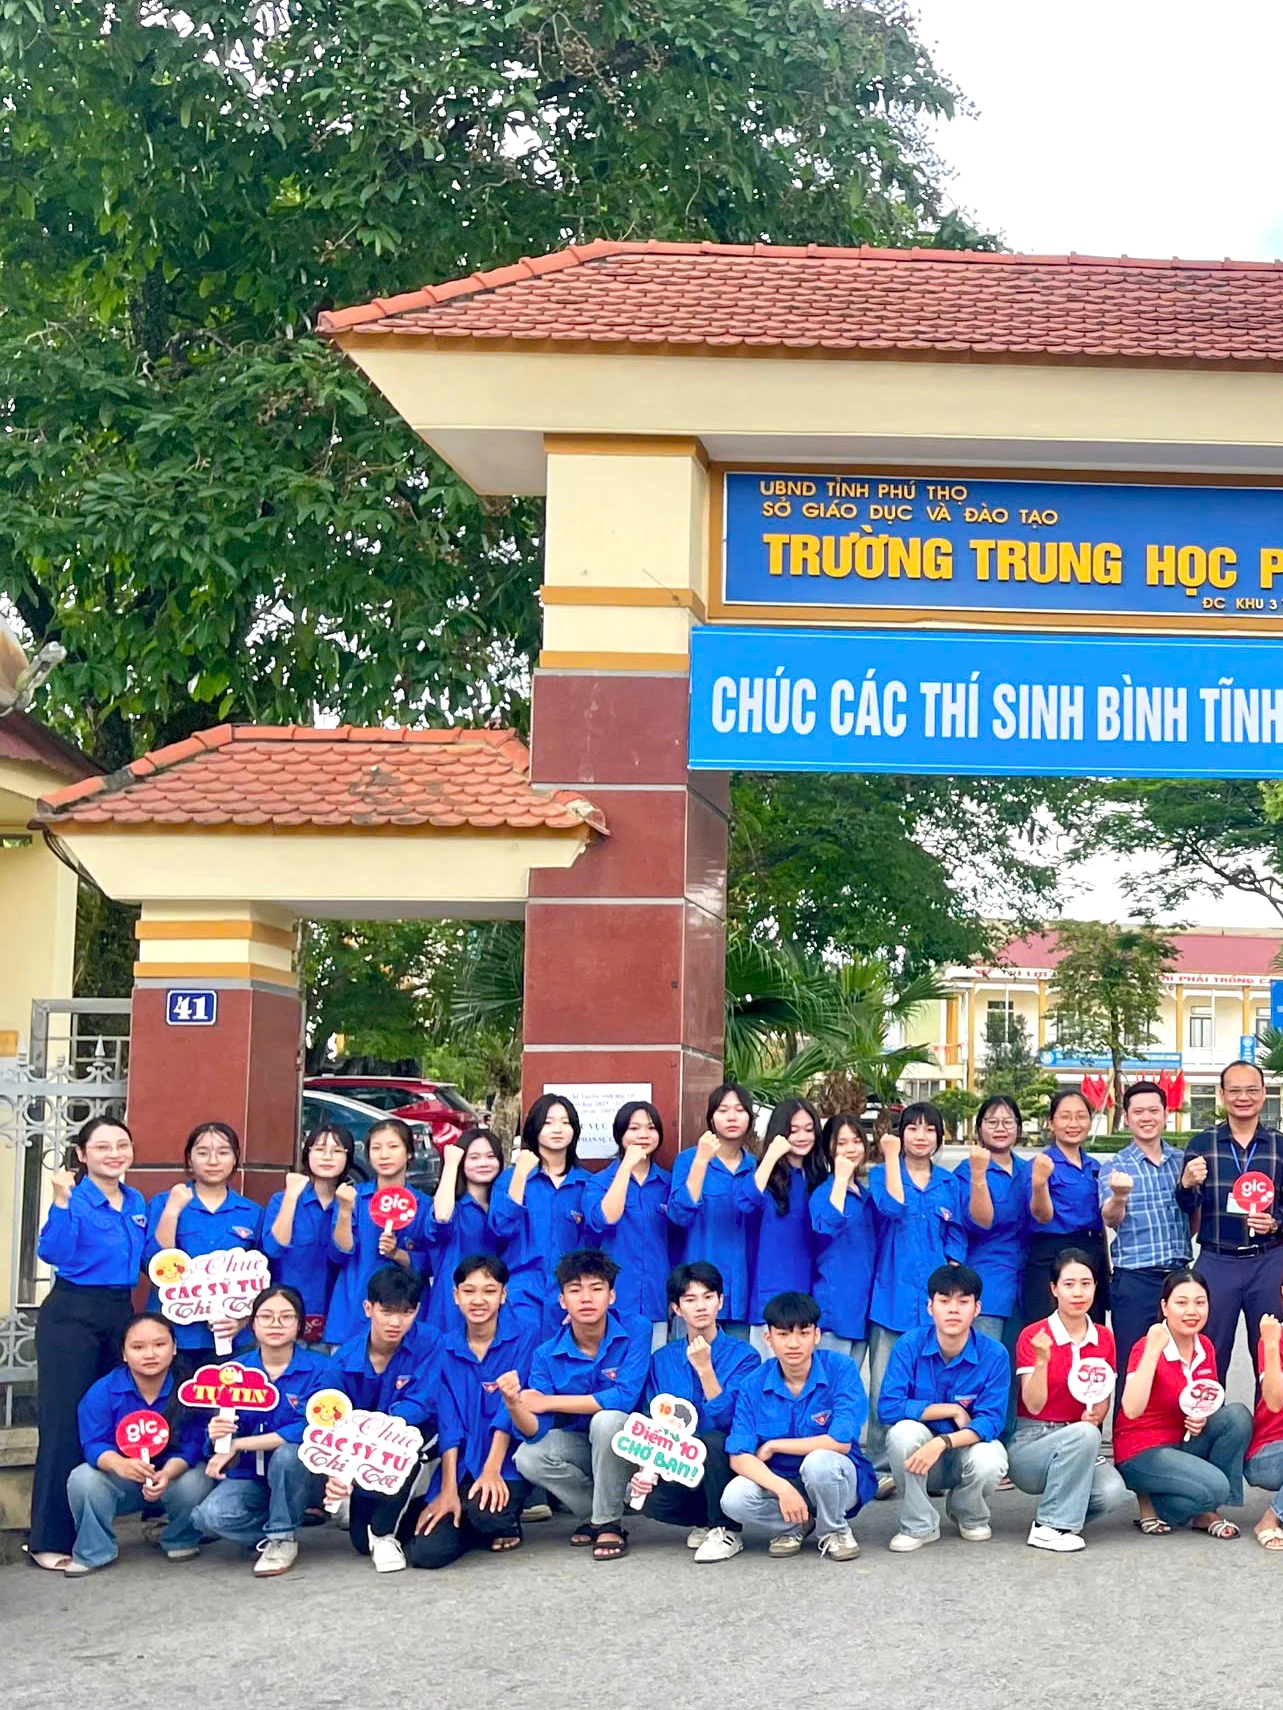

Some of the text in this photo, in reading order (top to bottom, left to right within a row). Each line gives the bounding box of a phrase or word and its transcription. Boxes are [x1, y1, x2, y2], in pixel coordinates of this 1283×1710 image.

[760, 477, 967, 505] UBND TỈNH PHÚ THỌ
[762, 497, 1058, 530] SỞ GIÁO DỤC VÀ ĐÀO TẠO
[762, 526, 953, 580] TRƯỜNG
[970, 540, 1122, 585] TRUNG
[1145, 545, 1237, 597] HỌC
[1236, 598, 1264, 610] KHU
[1269, 599, 1278, 610] 3
[713, 667, 817, 735] CHÚC
[831, 668, 907, 738] CÁC
[921, 672, 980, 739] THÍ
[993, 683, 1084, 740] SINH
[1098, 675, 1188, 742] BÌNH
[173, 996, 208, 1020] 41
[193, 1384, 268, 1406] TỰ TIN
[680, 1441, 699, 1461] 10
